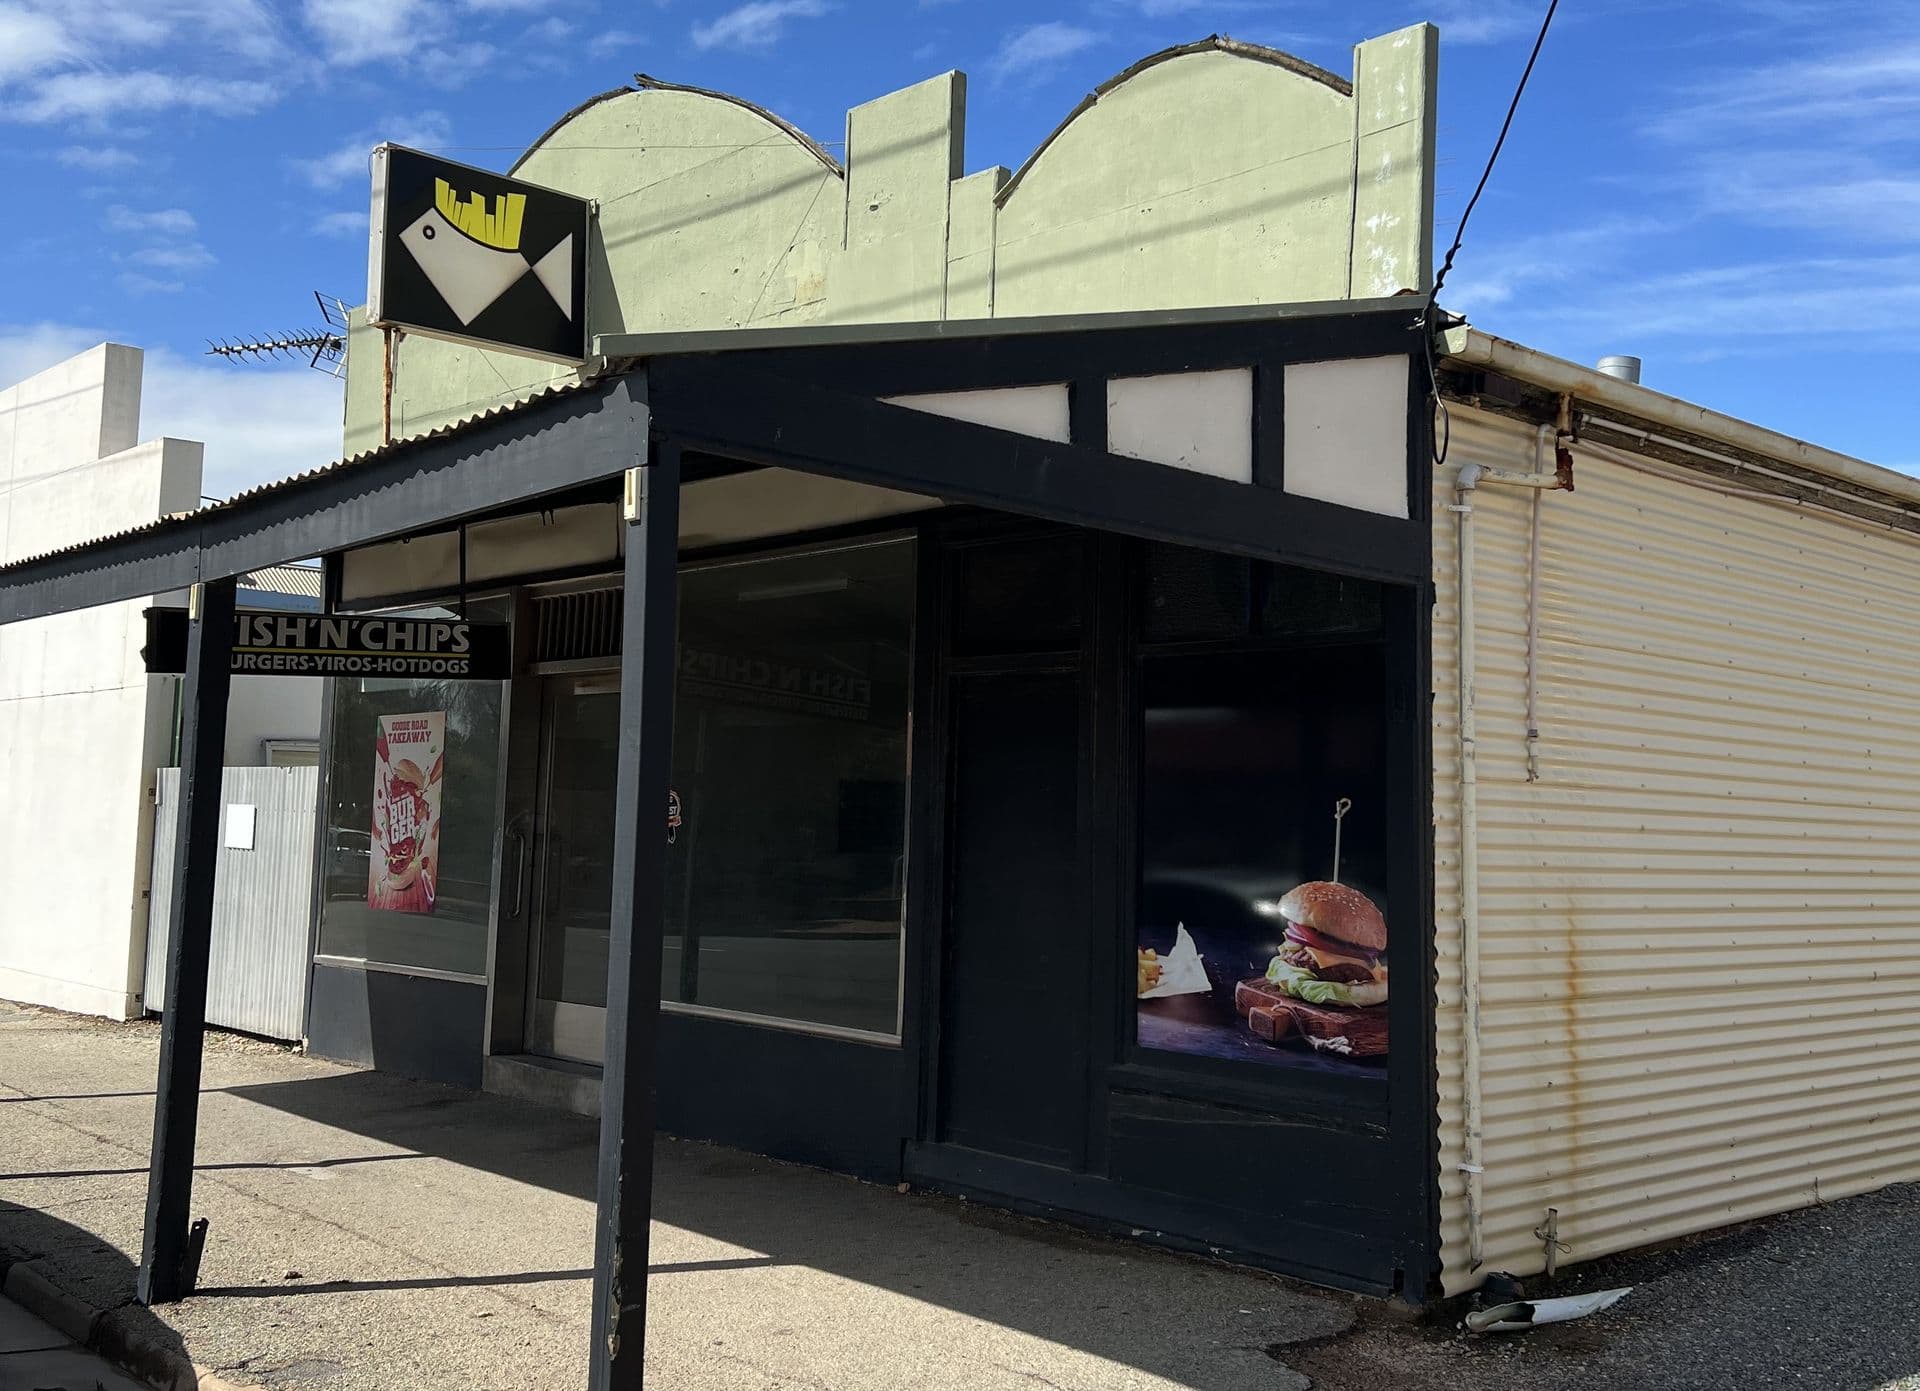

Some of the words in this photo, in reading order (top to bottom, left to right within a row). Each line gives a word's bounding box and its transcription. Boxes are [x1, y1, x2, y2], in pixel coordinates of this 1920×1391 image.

[234, 615, 470, 652] ISH'N'CHIPS
[231, 653, 470, 674] URGERS-YIROS-HOTDOGS
[411, 720, 428, 730] ROAD
[388, 731, 431, 744] TAKEAWAY
